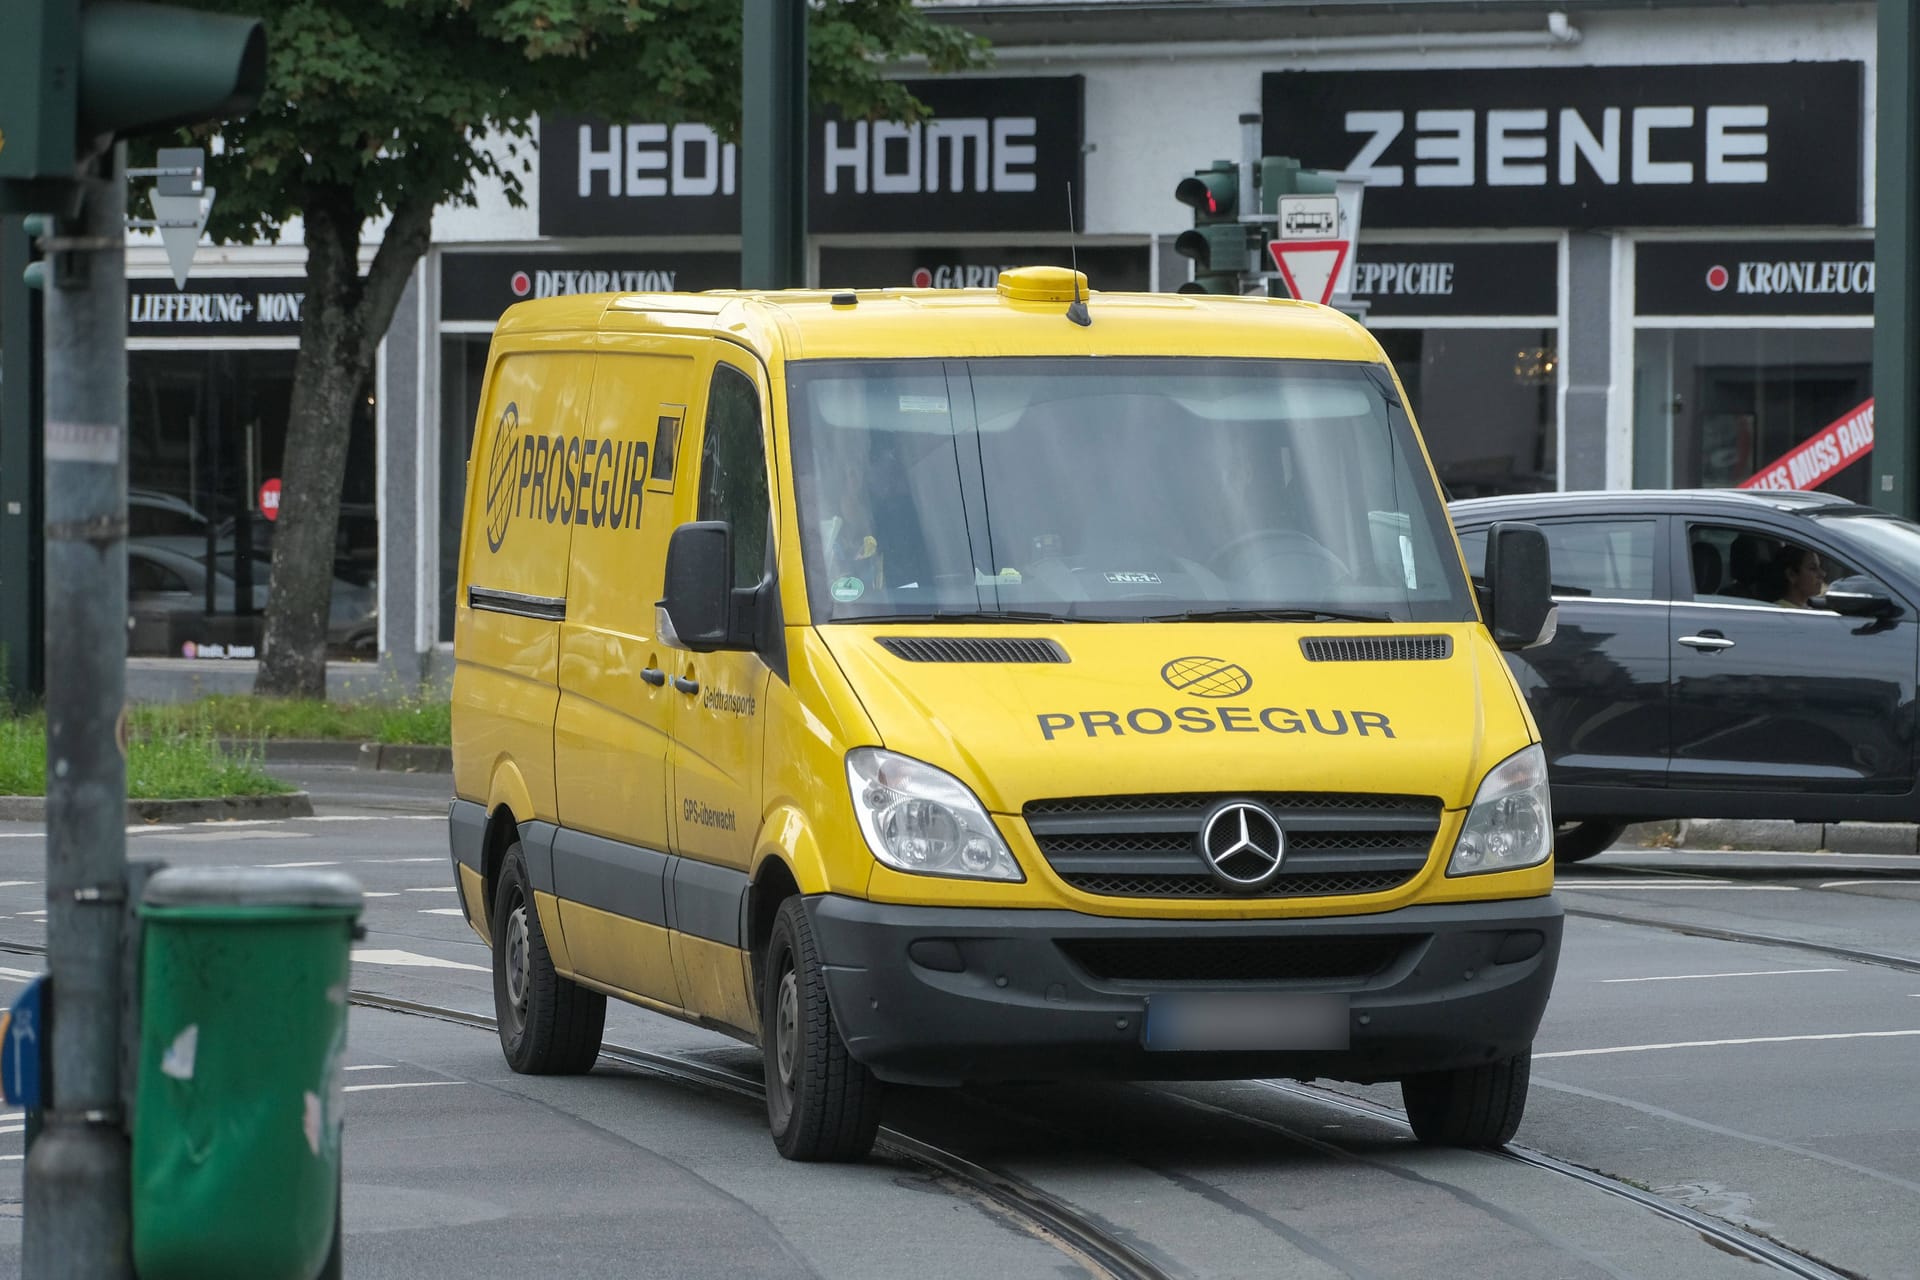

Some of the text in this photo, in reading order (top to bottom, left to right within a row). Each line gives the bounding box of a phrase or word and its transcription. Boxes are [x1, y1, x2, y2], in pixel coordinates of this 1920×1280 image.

[824, 117, 1036, 194] HOME
[535, 270, 677, 299] DEKORATION
[933, 265, 1016, 288] GARD
[1352, 262, 1454, 295] EPPICHE
[257, 293, 305, 322] MON
[1788, 434, 1841, 489] MUSS
[516, 434, 649, 530] PROSEGUR
[703, 686, 755, 719] Geldtransporte
[1036, 707, 1397, 740] PROSEGUR
[683, 798, 736, 832] GPS-überwacht
